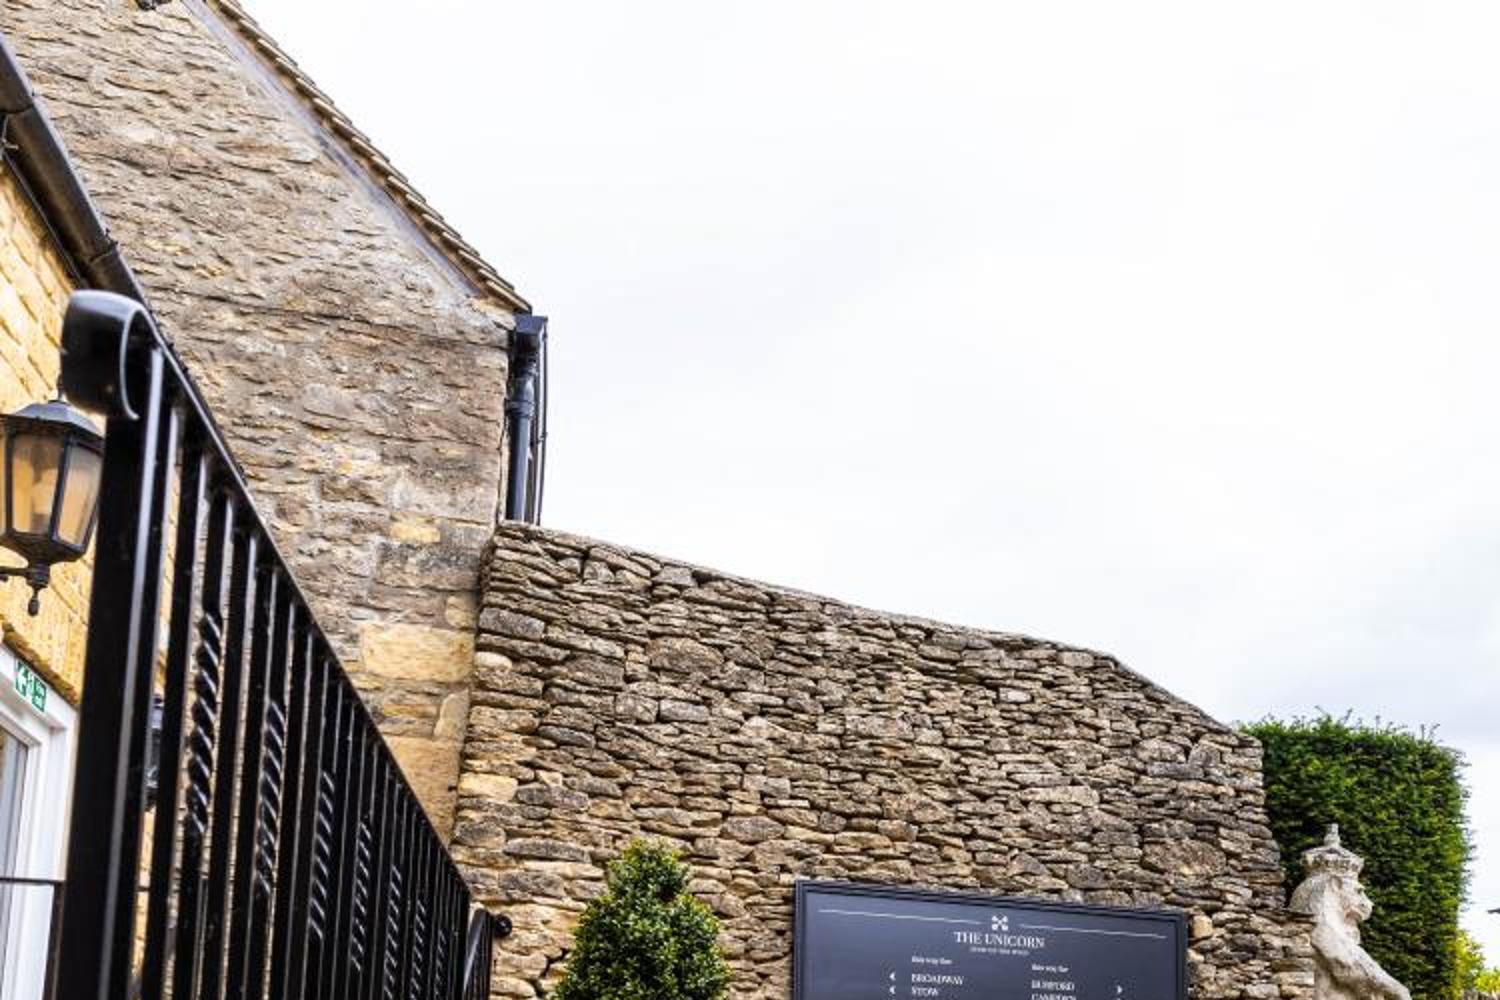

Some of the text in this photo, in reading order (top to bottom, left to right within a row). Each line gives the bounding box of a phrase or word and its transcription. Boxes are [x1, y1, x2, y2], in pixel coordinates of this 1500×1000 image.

[953, 931, 1046, 948] THE UNICORN
[911, 973, 964, 985] BROADWAY
